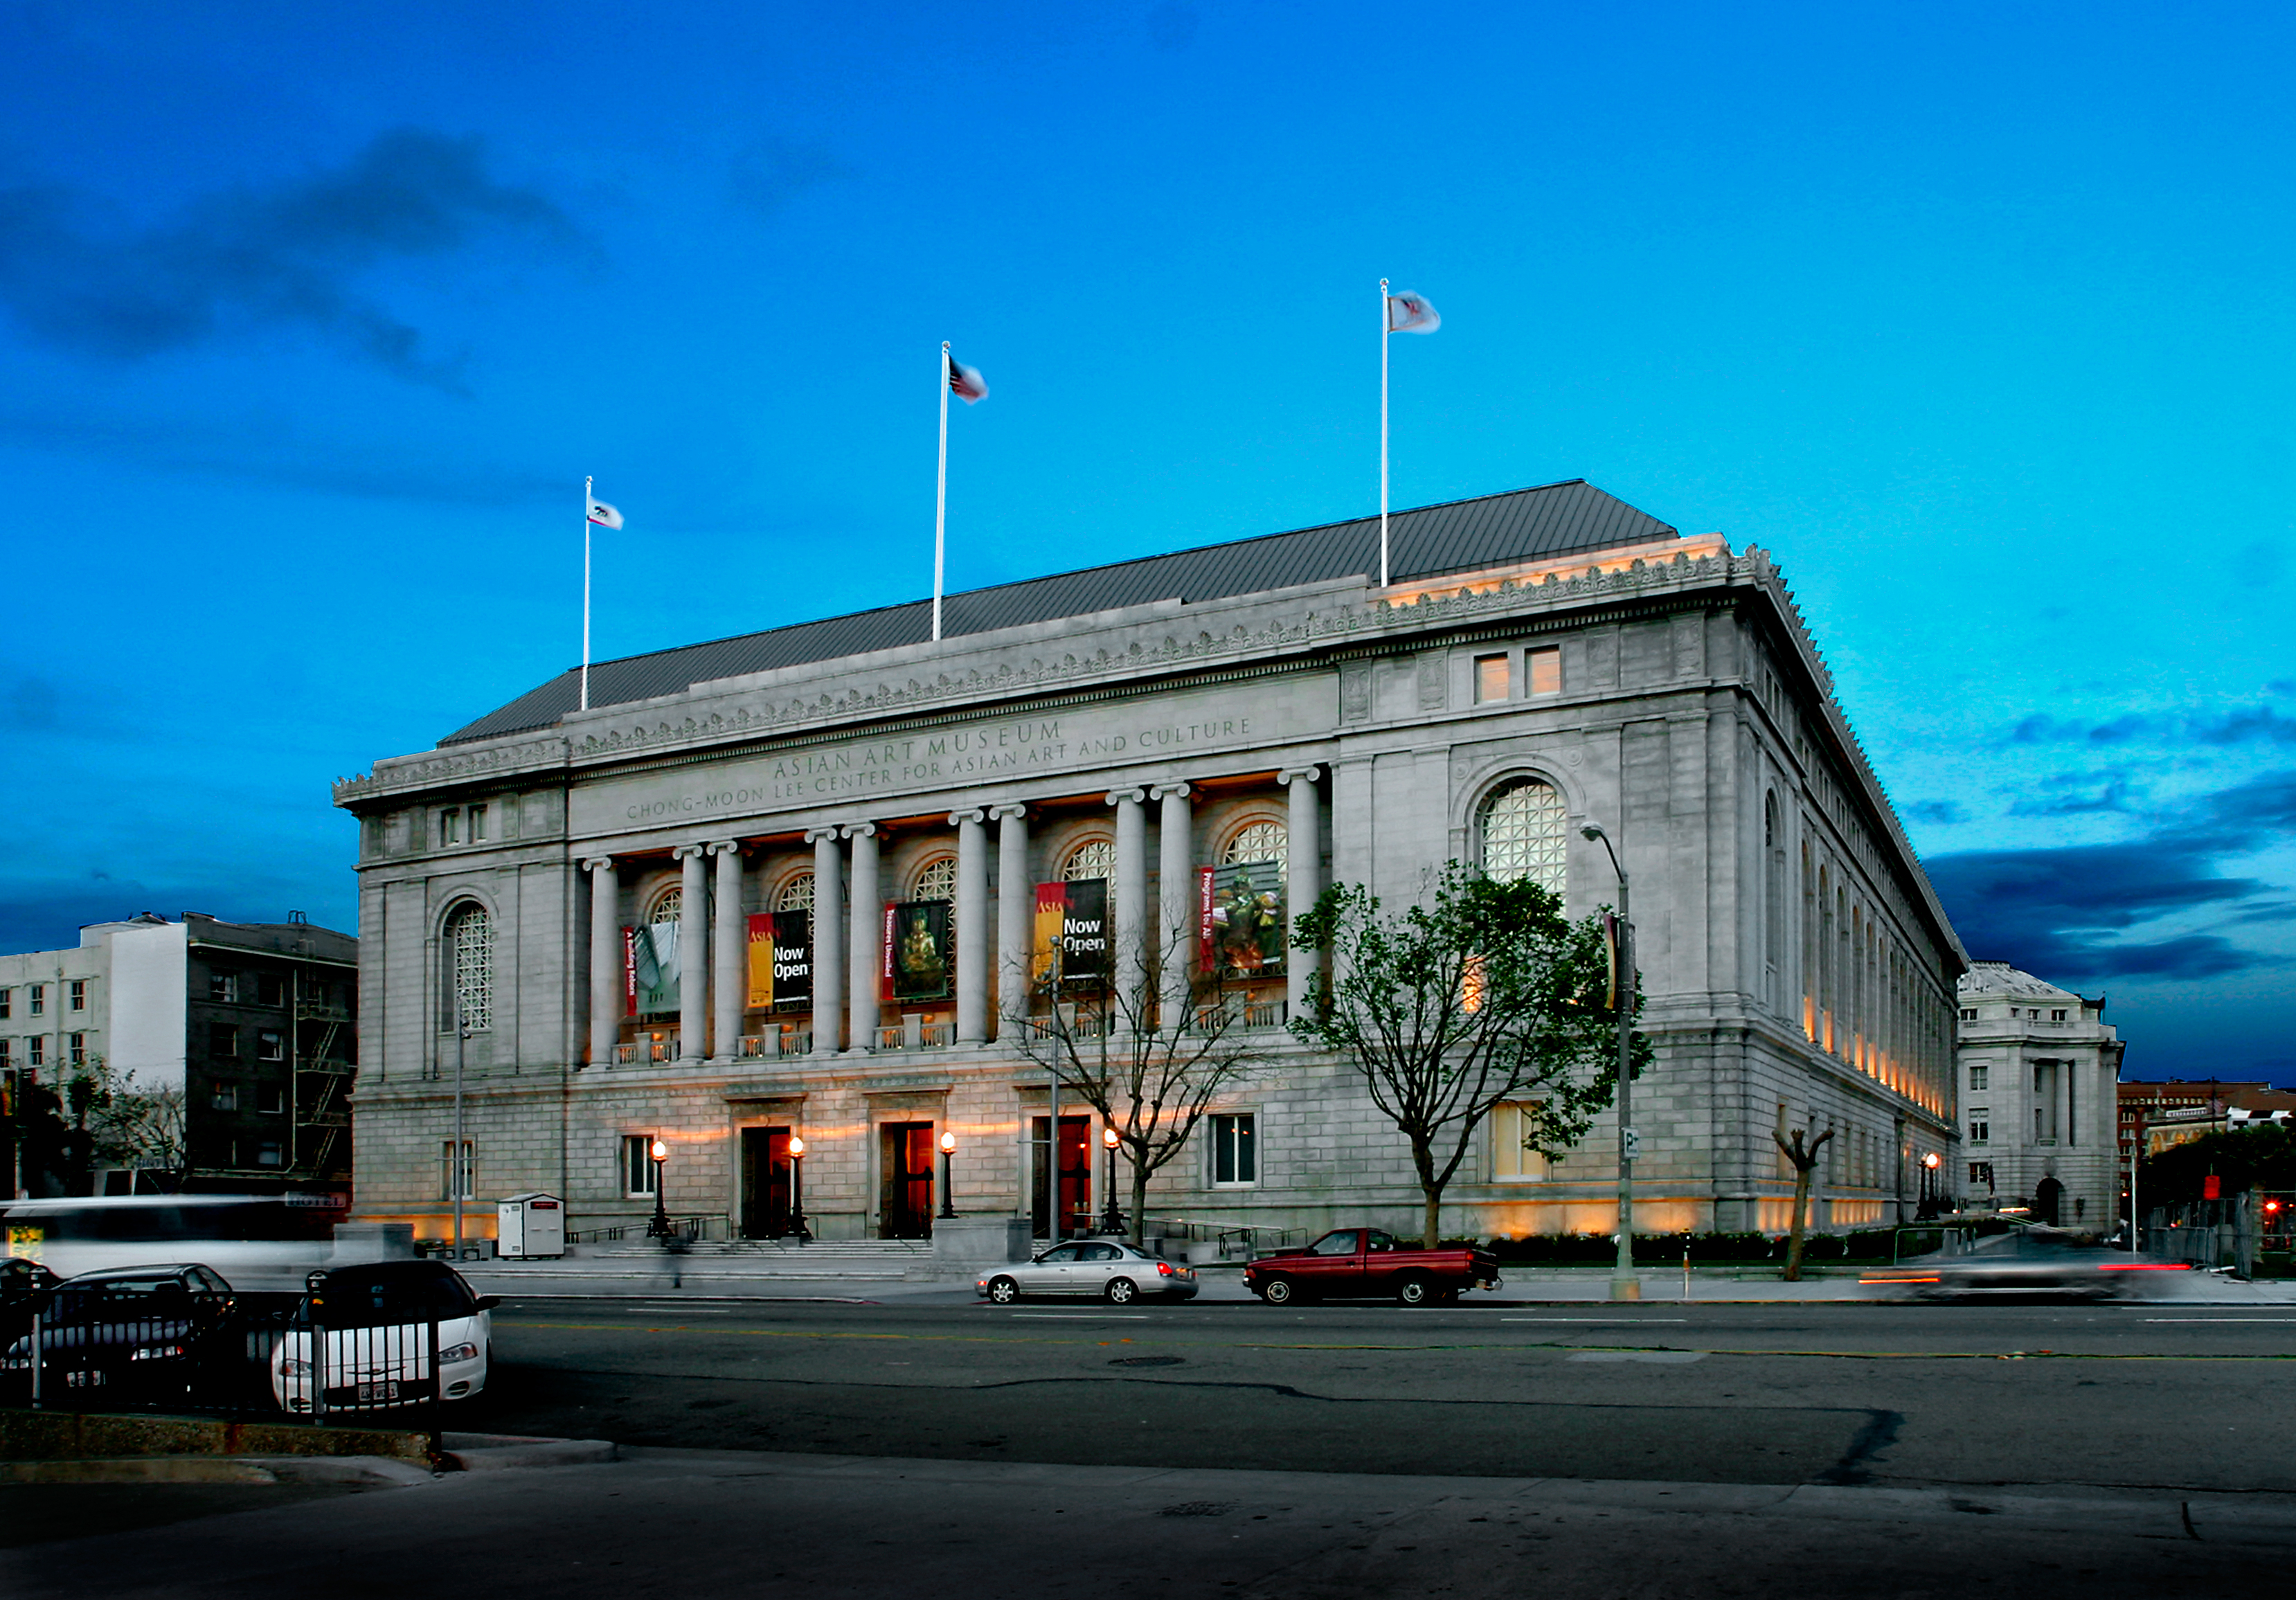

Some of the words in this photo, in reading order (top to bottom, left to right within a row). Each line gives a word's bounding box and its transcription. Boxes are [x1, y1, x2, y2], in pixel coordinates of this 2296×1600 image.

[775, 750, 850, 779] ASIAN
[864, 741, 914, 766] ART
[928, 721, 1059, 756] MUSEUM
[627, 788, 763, 819] CHONG-MOON
[775, 782, 803, 798] LEE
[815, 769, 891, 793] CENTER
[904, 763, 941, 780] FOR
[952, 752, 1016, 774] ASIAN
[1028, 744, 1067, 763] ART
[1079, 736, 1127, 755] AND
[1139, 719, 1250, 747] CULTURE
[1064, 918, 1101, 935] Now
[774, 946, 805, 962] Now
[1064, 936, 1106, 956] Open
[774, 963, 809, 981] Open
